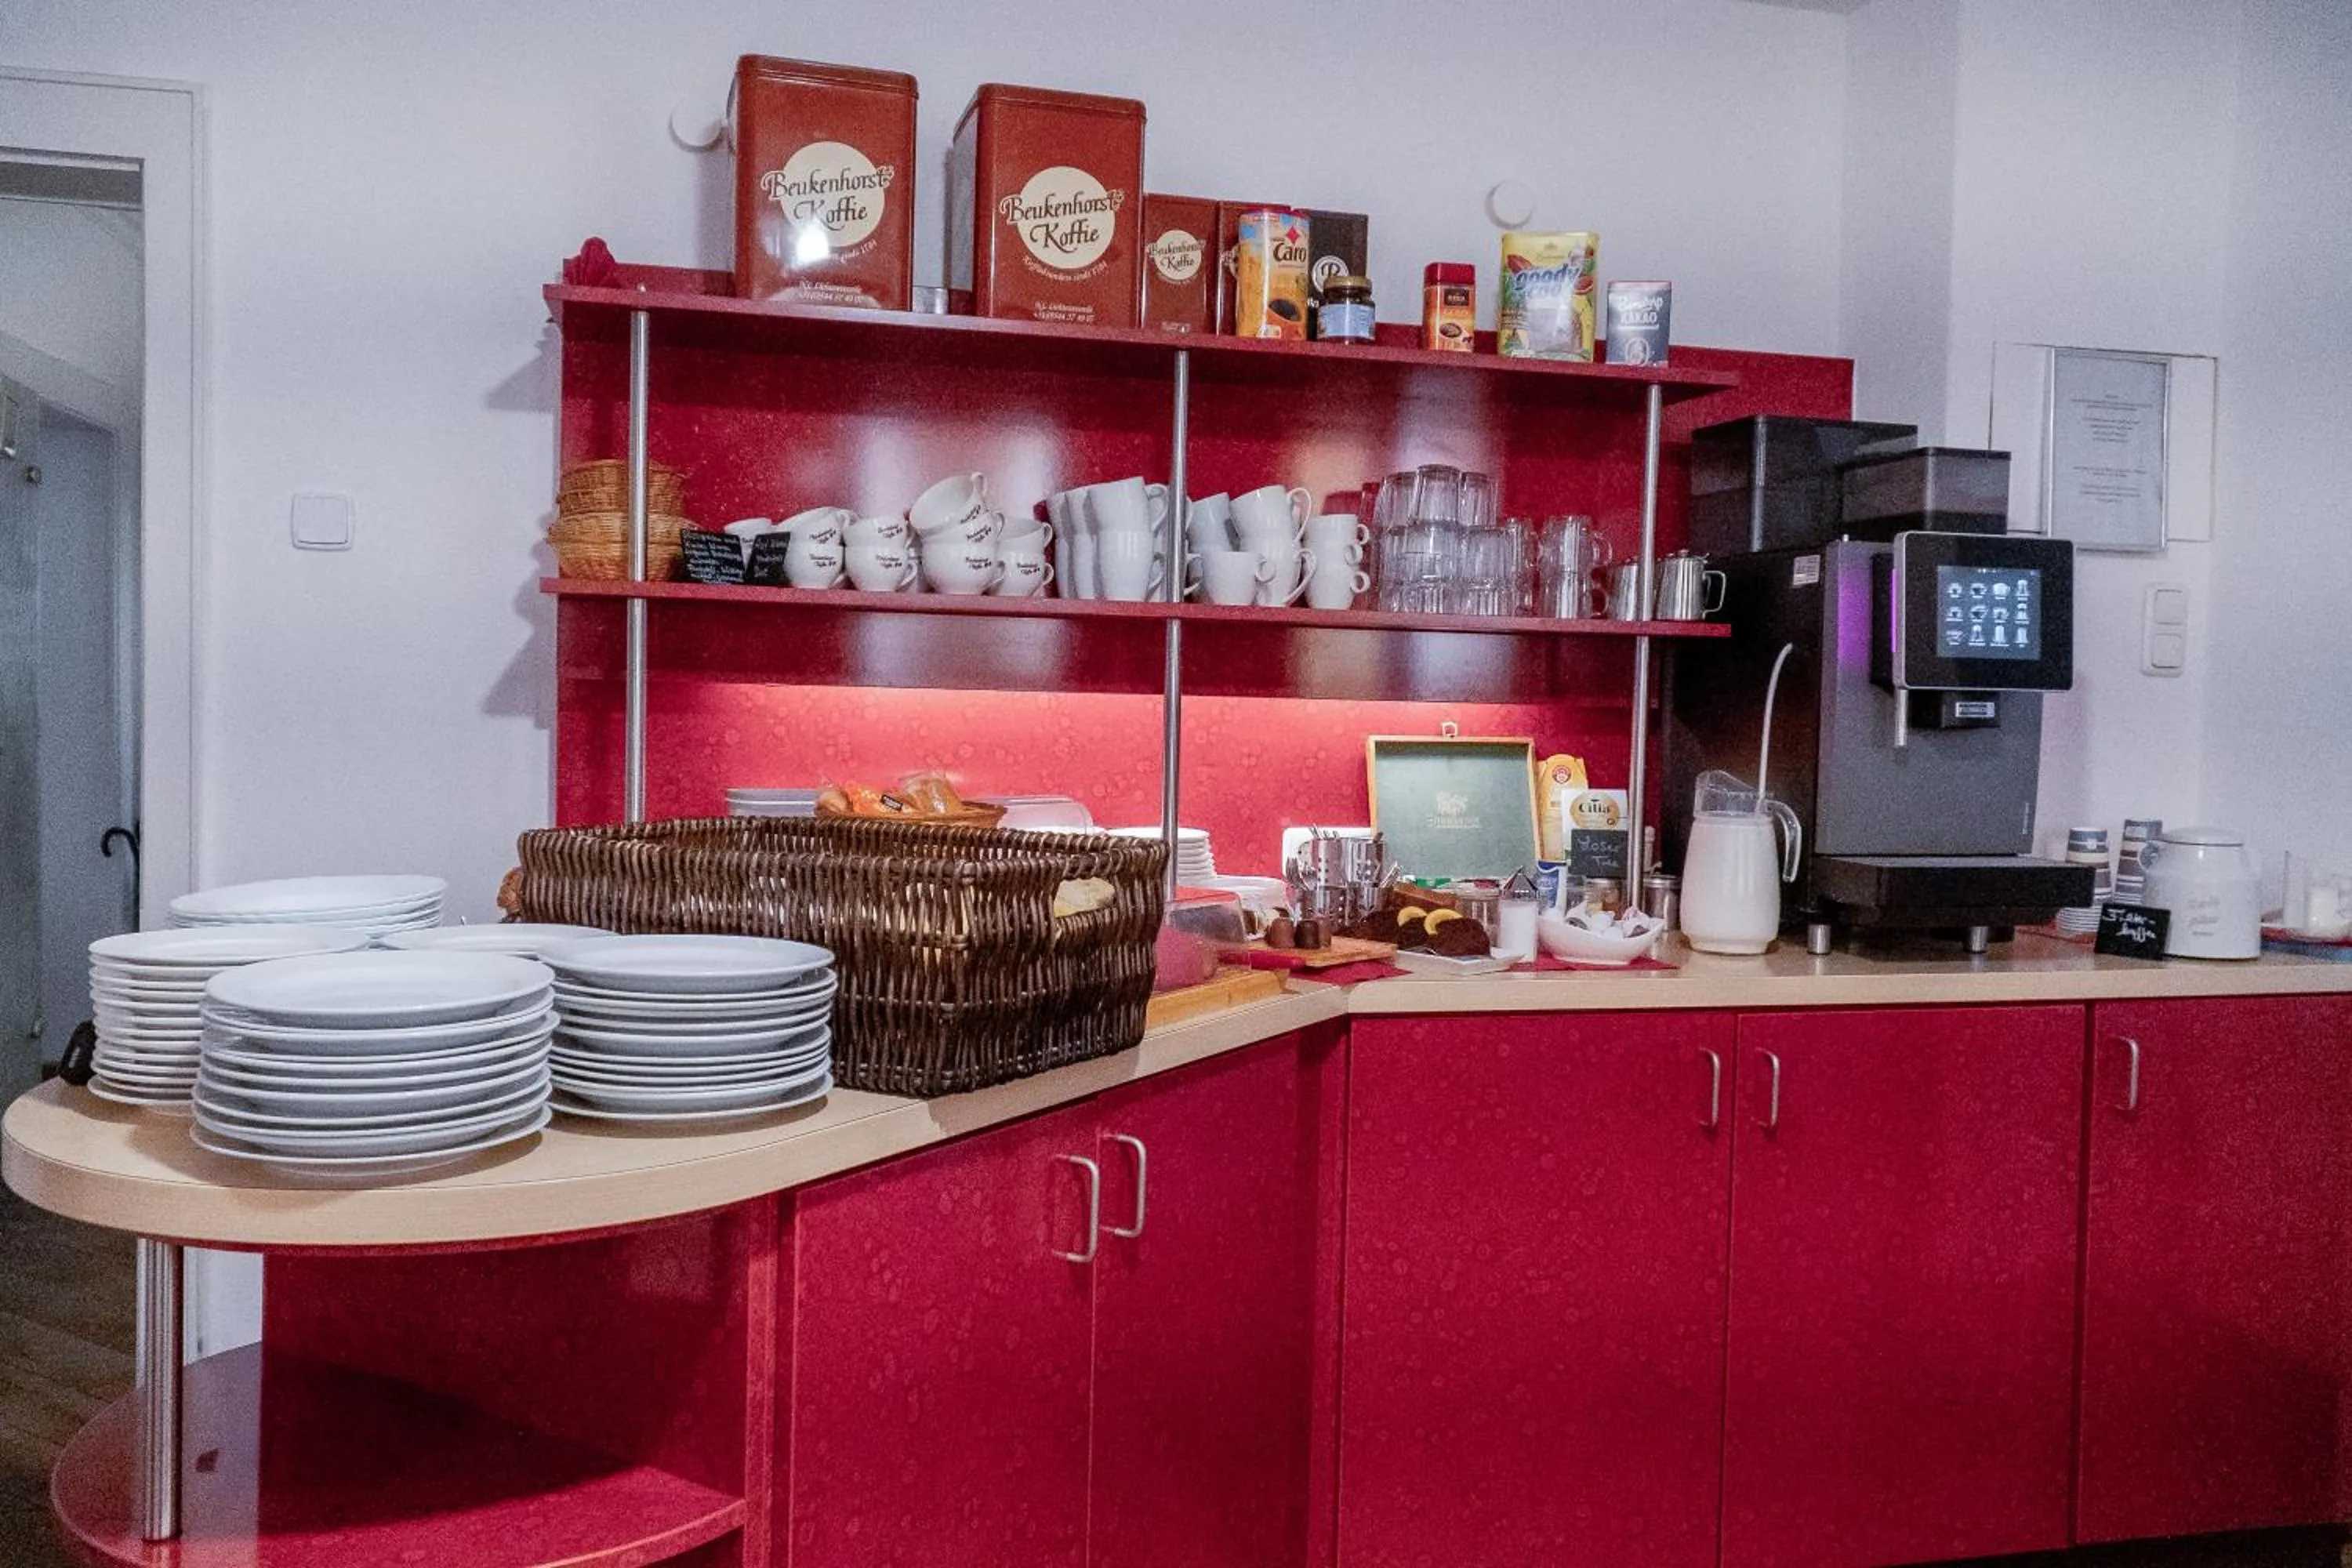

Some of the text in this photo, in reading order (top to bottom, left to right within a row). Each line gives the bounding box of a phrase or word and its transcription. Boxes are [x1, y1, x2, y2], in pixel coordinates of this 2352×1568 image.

[760, 165, 894, 201] Beukenhorst
[793, 196, 868, 231] Koffie
[1000, 189, 1124, 224] Beukenhorst
[1029, 220, 1100, 253] Koffie
[1273, 242, 1307, 263] Caro
